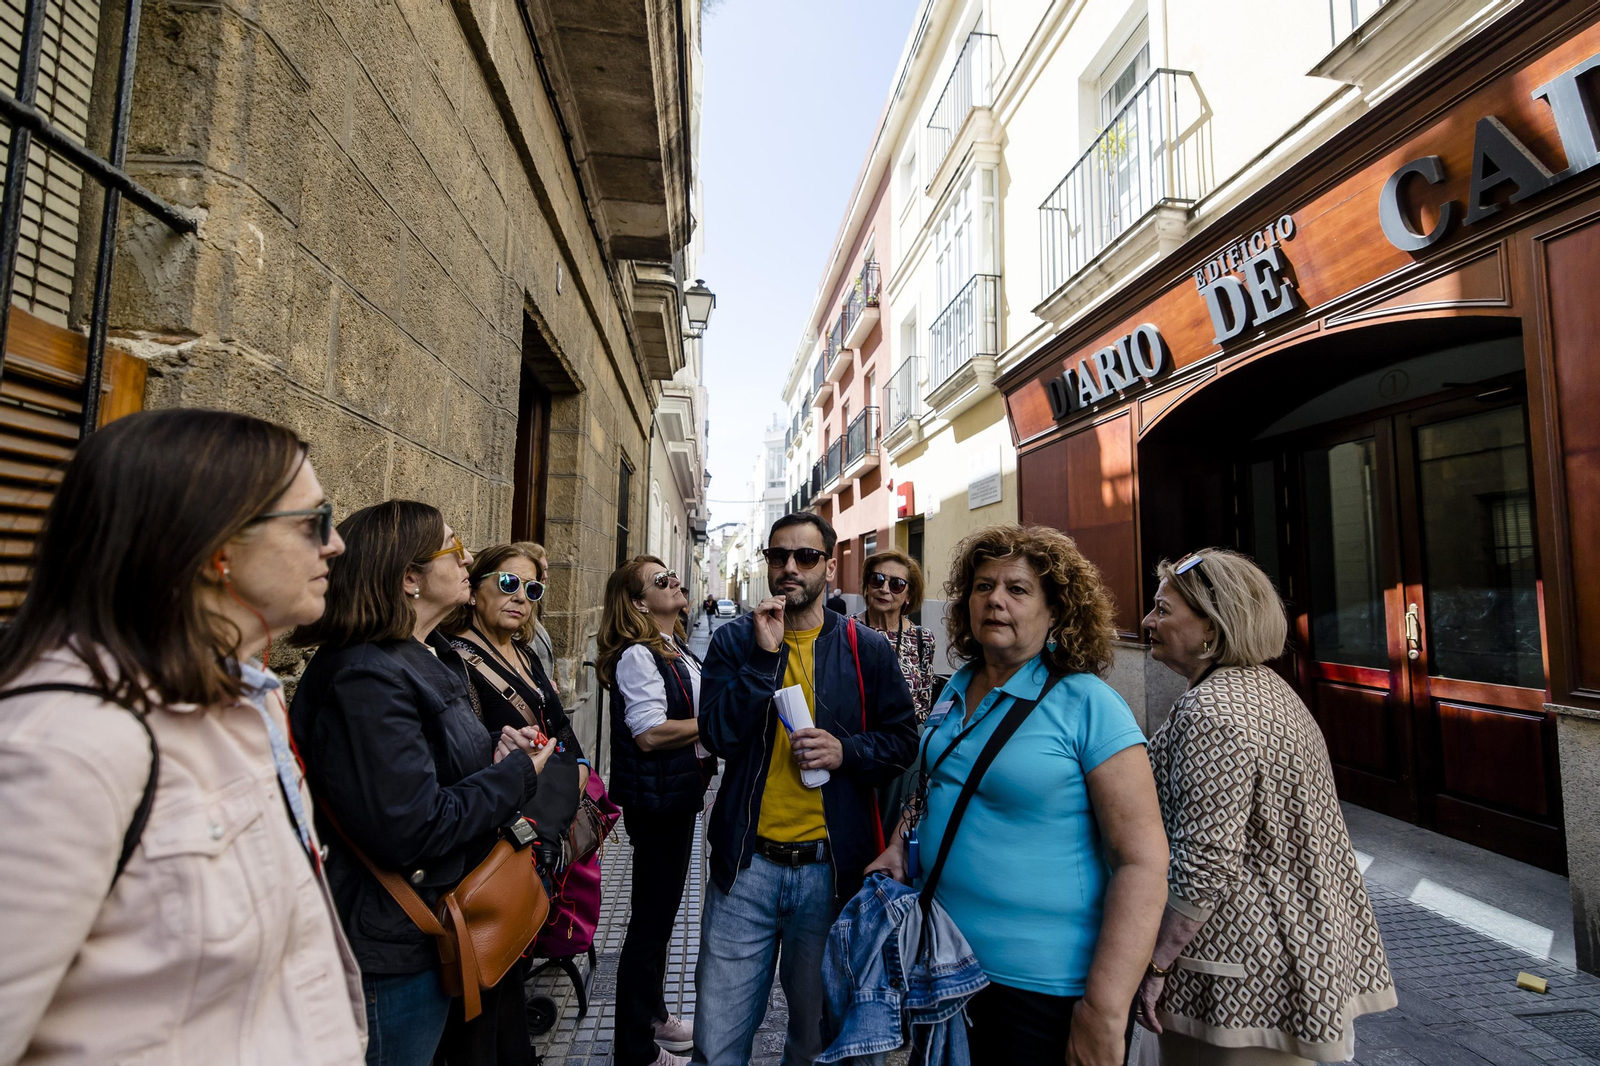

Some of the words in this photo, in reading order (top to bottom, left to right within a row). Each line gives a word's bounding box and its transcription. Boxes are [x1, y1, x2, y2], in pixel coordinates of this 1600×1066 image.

[1193, 214, 1294, 291] EDIFICIO
[1046, 323, 1162, 421] DIARIO
[1199, 245, 1295, 346] DE
